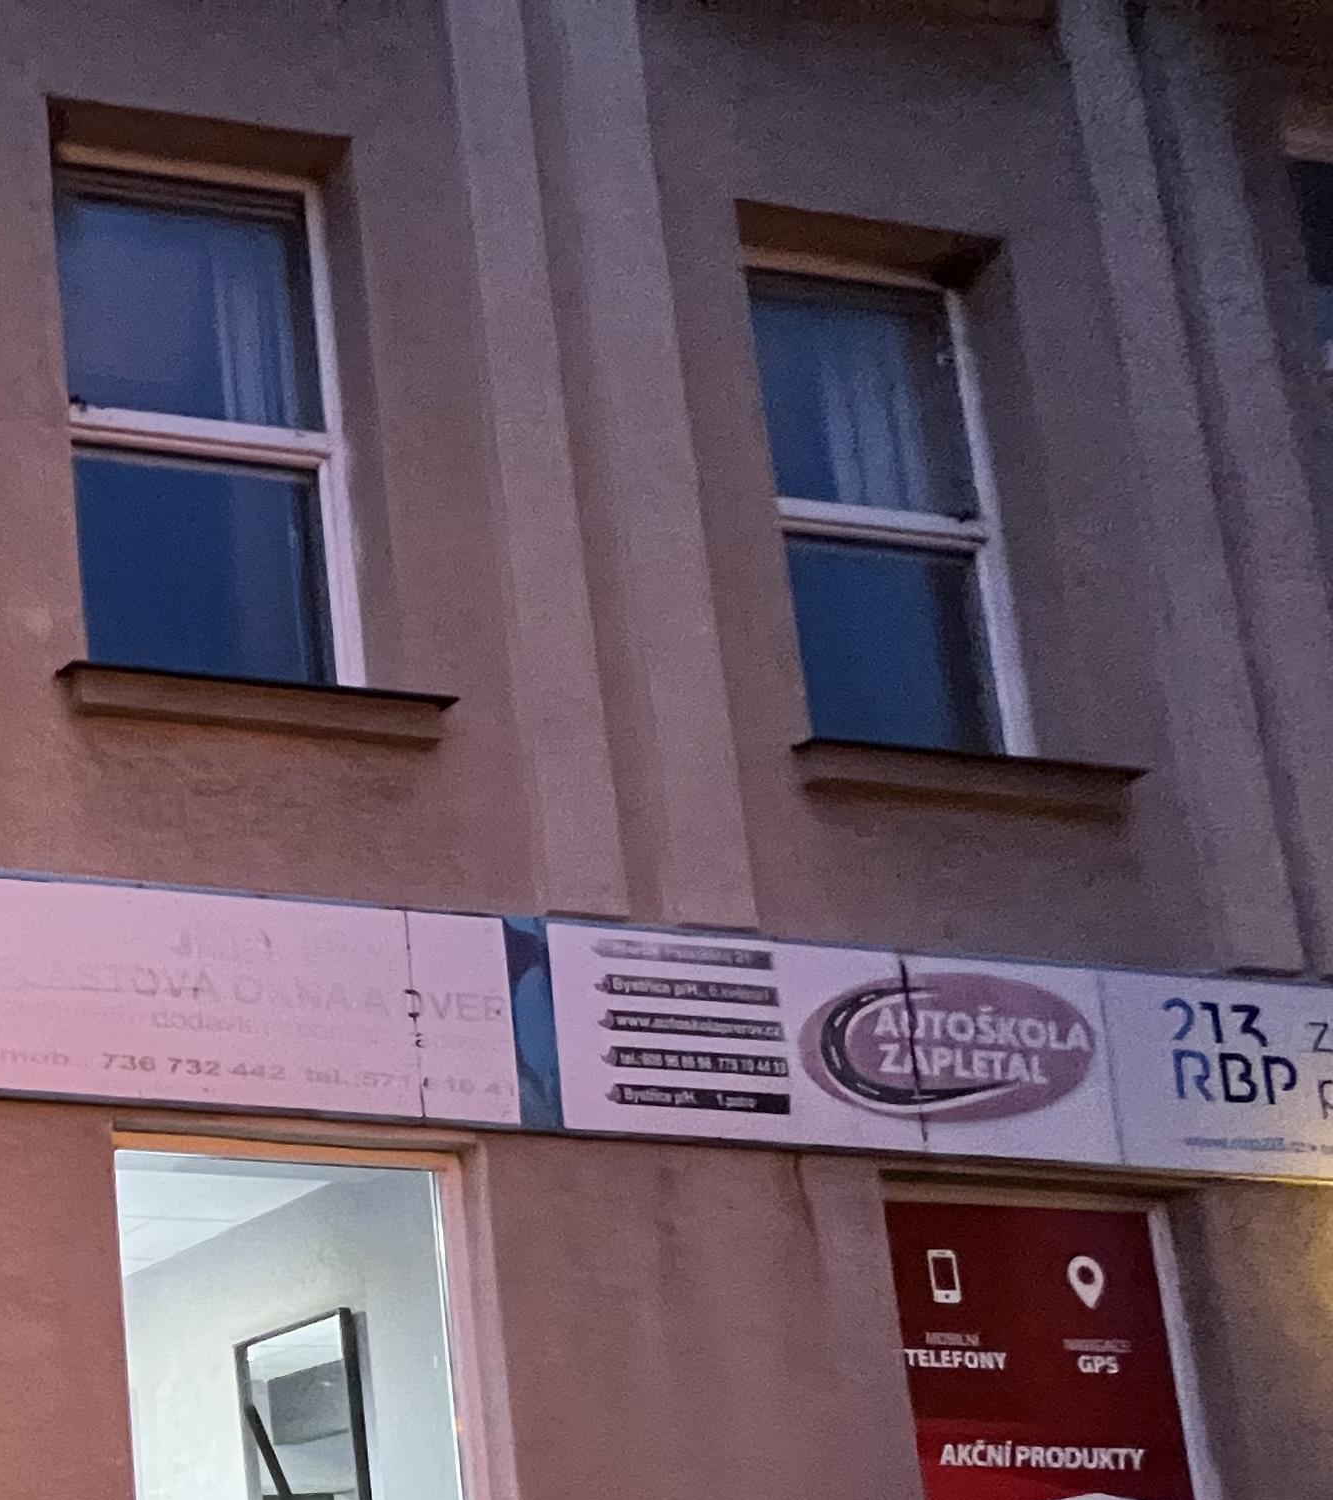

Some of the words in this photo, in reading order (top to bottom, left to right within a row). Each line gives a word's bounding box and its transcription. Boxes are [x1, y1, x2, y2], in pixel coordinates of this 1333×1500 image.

[874, 1005, 1092, 1051] AUTOŠKOLA
[169, 1056, 221, 1077] 732
[878, 1043, 1049, 1085] ZAPLETAL
[1173, 1049, 1298, 1105] RBP
[904, 1347, 1007, 1371] TELEFONY
[1077, 1354, 1120, 1374] GPS
[939, 1439, 1013, 1468] AKČNÍ
[1014, 1445, 1145, 1471] PRODUKTY
